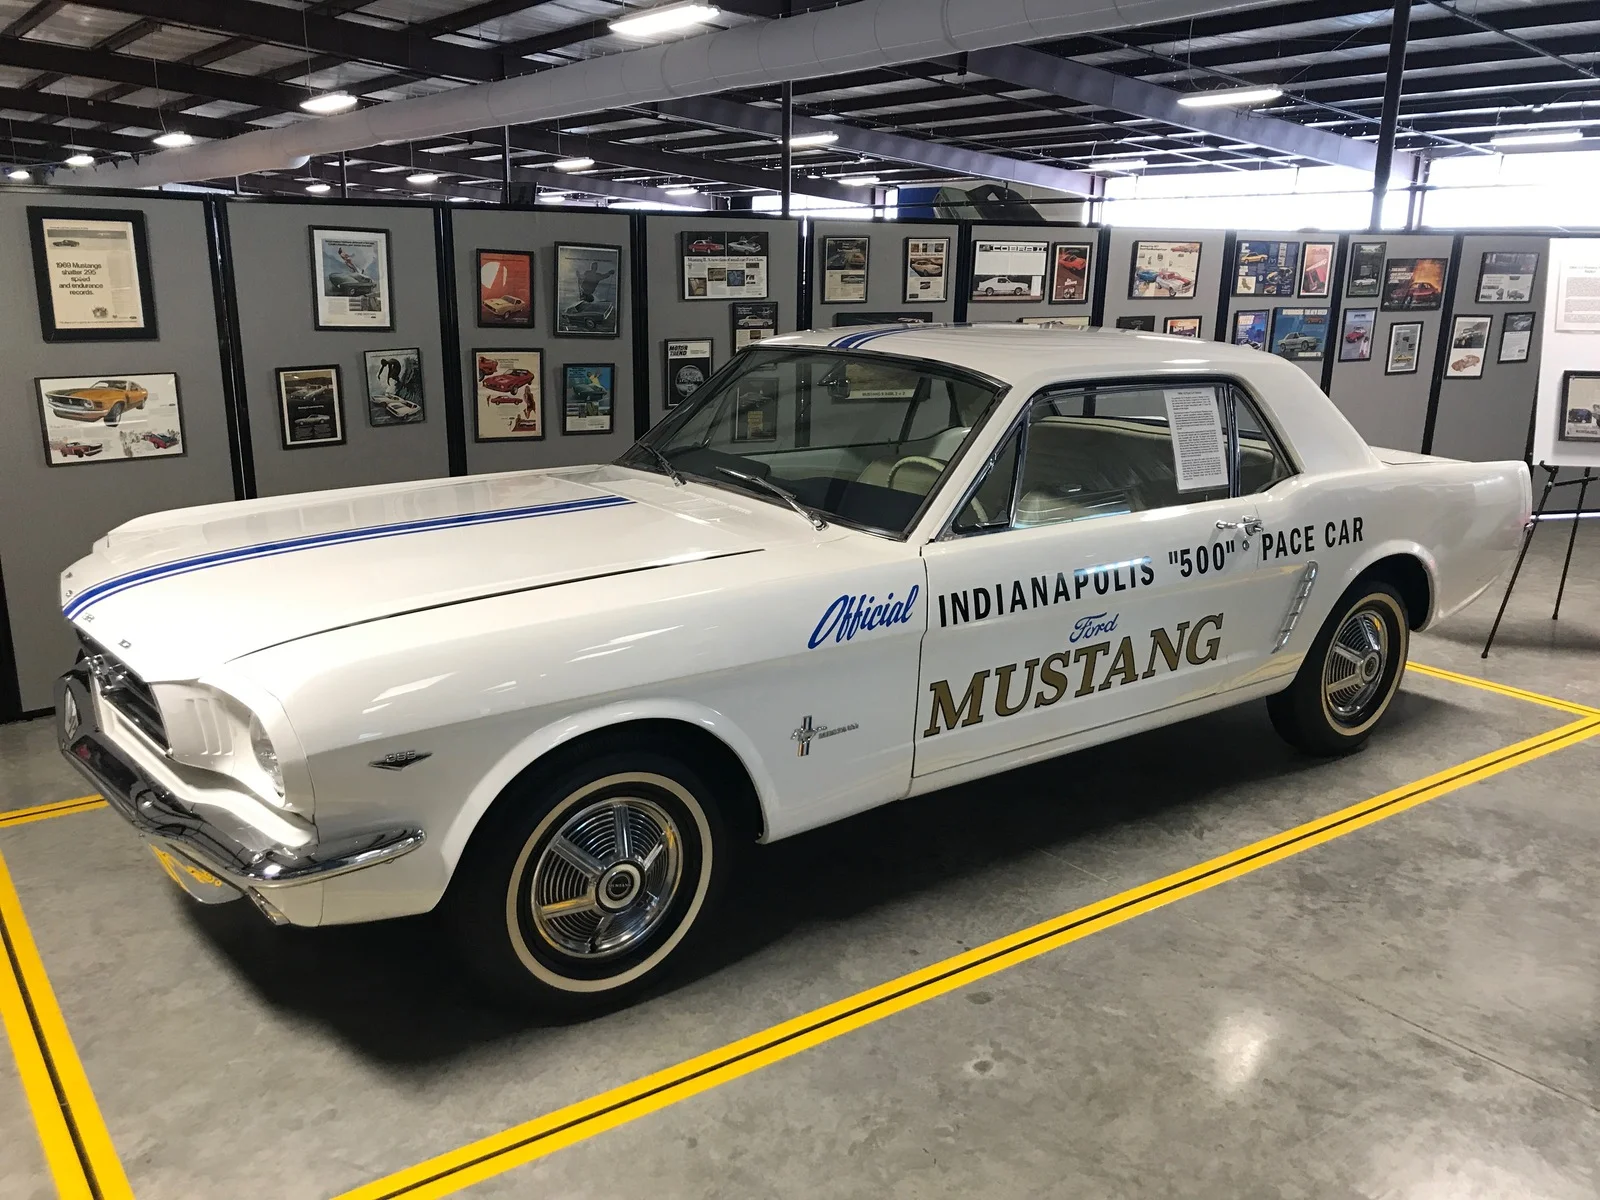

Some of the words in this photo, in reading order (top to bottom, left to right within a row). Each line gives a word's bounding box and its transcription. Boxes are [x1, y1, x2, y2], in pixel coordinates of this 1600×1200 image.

[807, 584, 919, 649] Official
[938, 556, 1155, 627] INDIANAPOLIS
[1168, 540, 1235, 577] "500"
[1261, 525, 1315, 561] PACE
[1324, 516, 1364, 548] CAR
[1069, 611, 1120, 643] Ford
[923, 613, 1225, 738] MUSTANG
